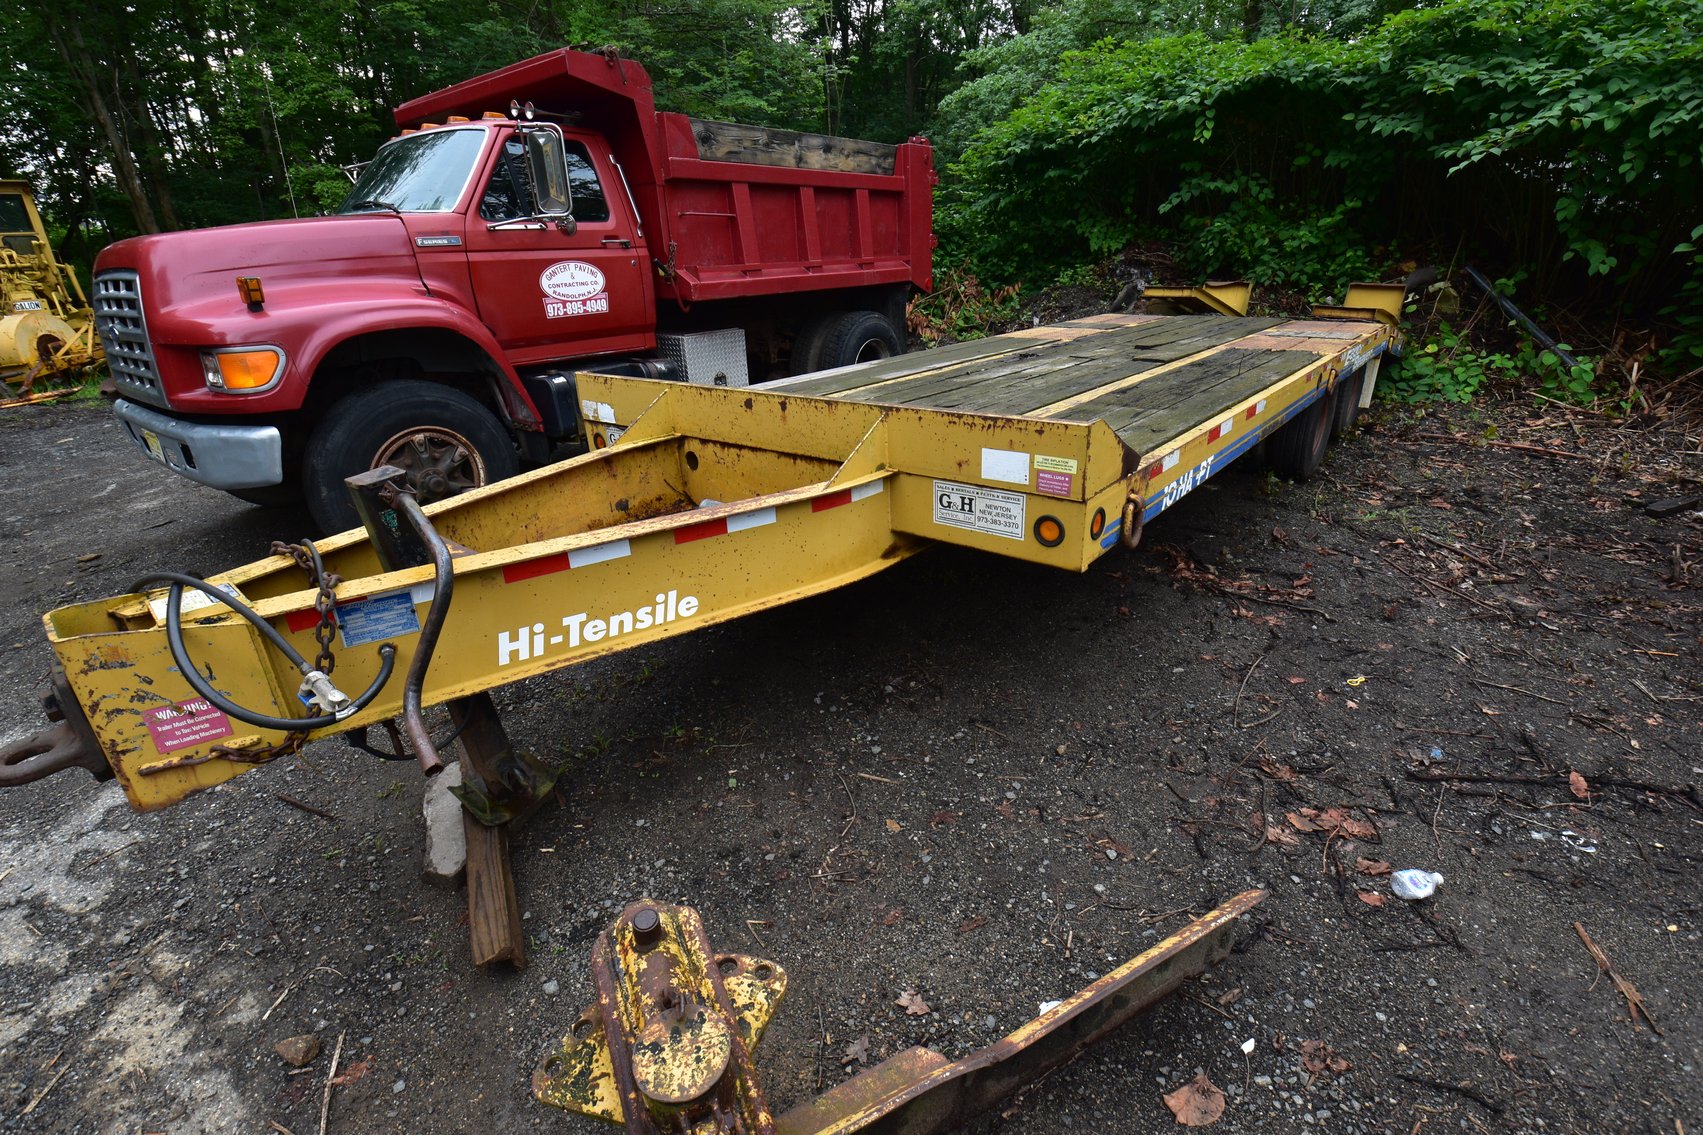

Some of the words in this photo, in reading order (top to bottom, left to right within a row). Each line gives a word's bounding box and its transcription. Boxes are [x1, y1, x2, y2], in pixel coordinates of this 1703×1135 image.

[545, 264, 571, 281] GANTERT
[574, 264, 598, 278] PAVING
[571, 272, 575, 280] &
[548, 281, 589, 289] CONTRACTING
[15, 301, 41, 310] GALION
[547, 299, 607, 317] 973-895-4949
[985, 503, 1011, 513] NEWTON
[993, 511, 1017, 521] JERSEY
[976, 515, 1020, 530] 973-383-3370
[498, 589, 699, 666] Hi-Tensile
[157, 724, 173, 732] Trailer
[172, 719, 187, 728] Must
[194, 711, 221, 722] Connected
[191, 723, 210, 731] Vehicle
[165, 739, 180, 747] When
[180, 733, 200, 743] Loading
[199, 727, 226, 738] Machinery
